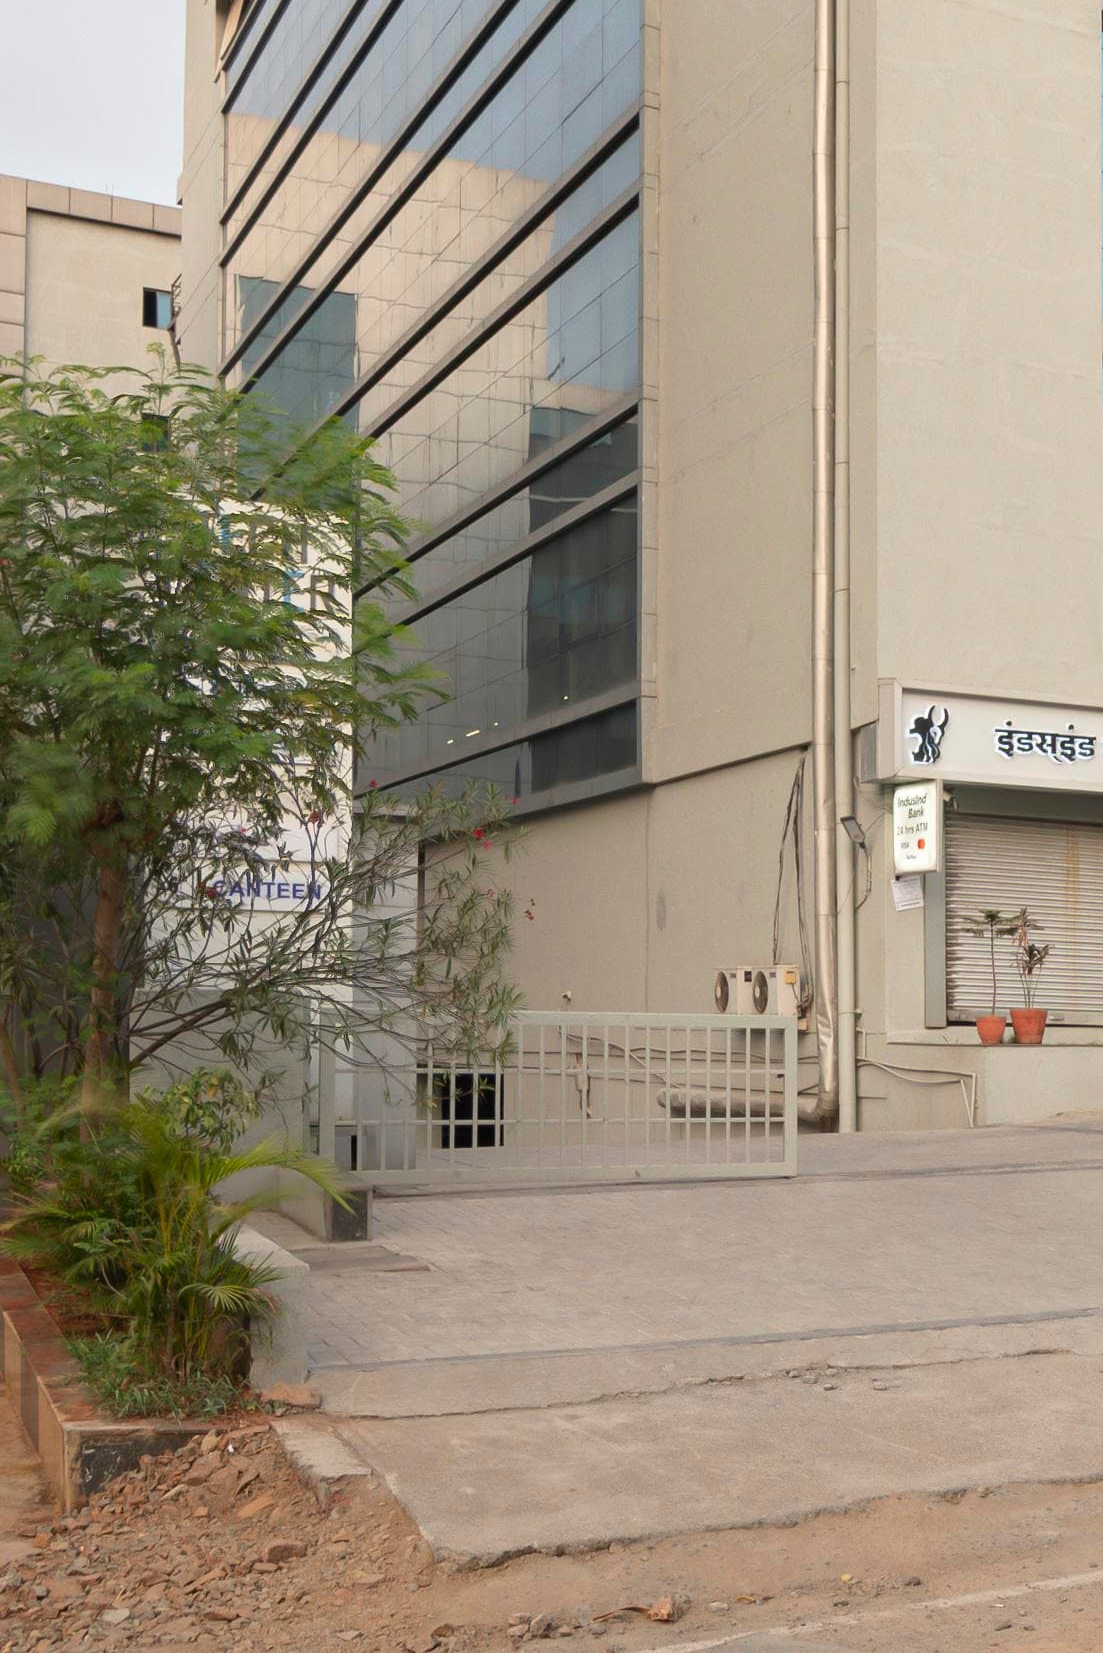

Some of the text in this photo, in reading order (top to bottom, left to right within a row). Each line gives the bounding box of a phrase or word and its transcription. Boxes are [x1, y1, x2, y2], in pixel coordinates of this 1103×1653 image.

[898, 793, 927, 807] IndusInd
[908, 807, 924, 818] Bank
[904, 825, 915, 836] hrs
[916, 823, 928, 833] ATM
[212, 879, 322, 901] CANTEEN
